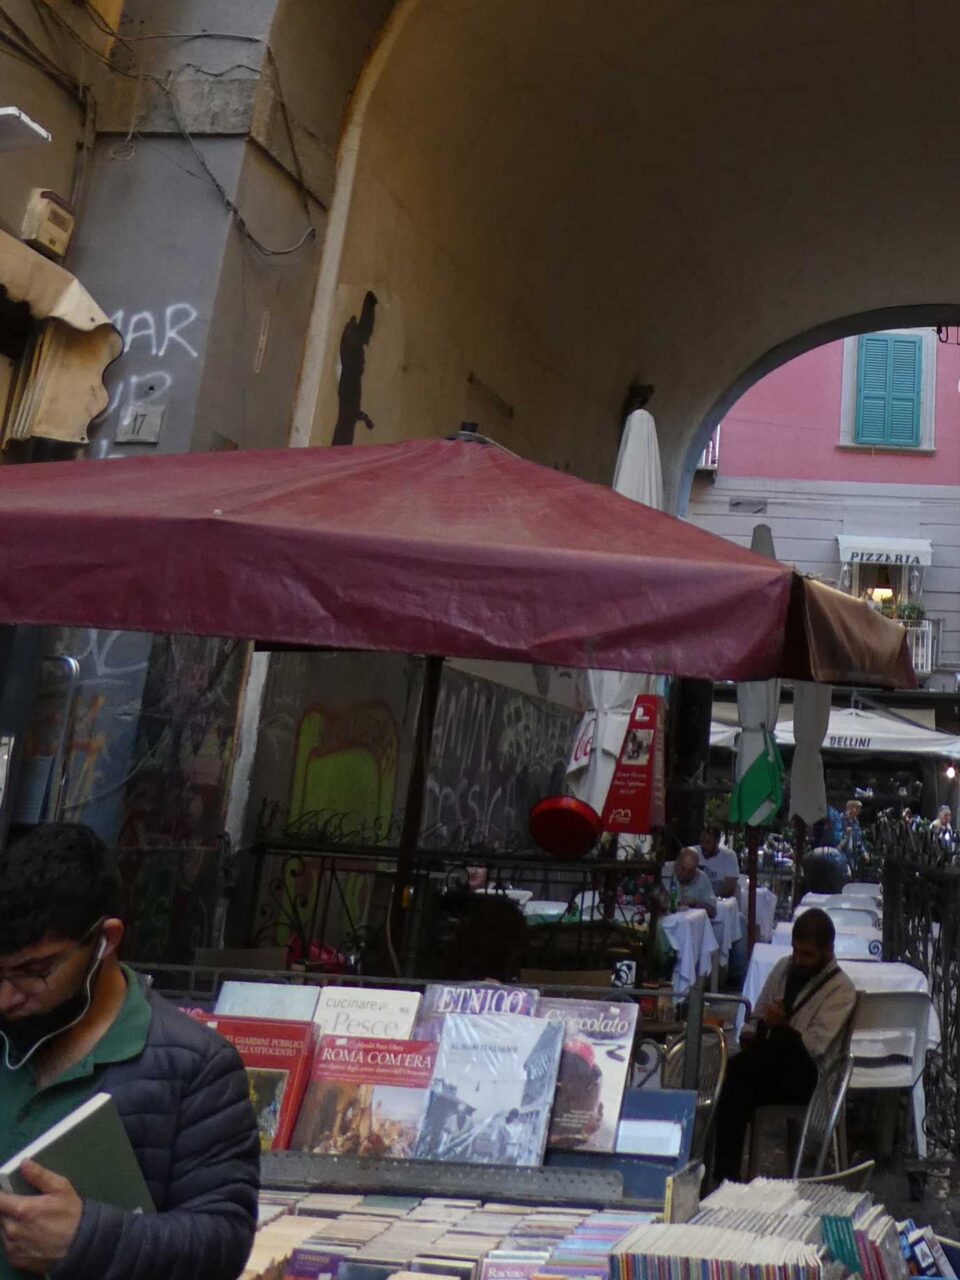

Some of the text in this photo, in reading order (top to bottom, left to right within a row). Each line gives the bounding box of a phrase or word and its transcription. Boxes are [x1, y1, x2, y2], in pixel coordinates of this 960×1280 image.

[132, 414, 147, 435] 17
[850, 552, 920, 564] PIZZERIA
[830, 736, 870, 747] BELLINI
[325, 997, 378, 1010] cucinare
[438, 987, 526, 1013] ETNICO
[332, 1011, 398, 1035] Pesce
[322, 1047, 364, 1064] ROMA
[367, 1051, 432, 1069] COM'ERA
